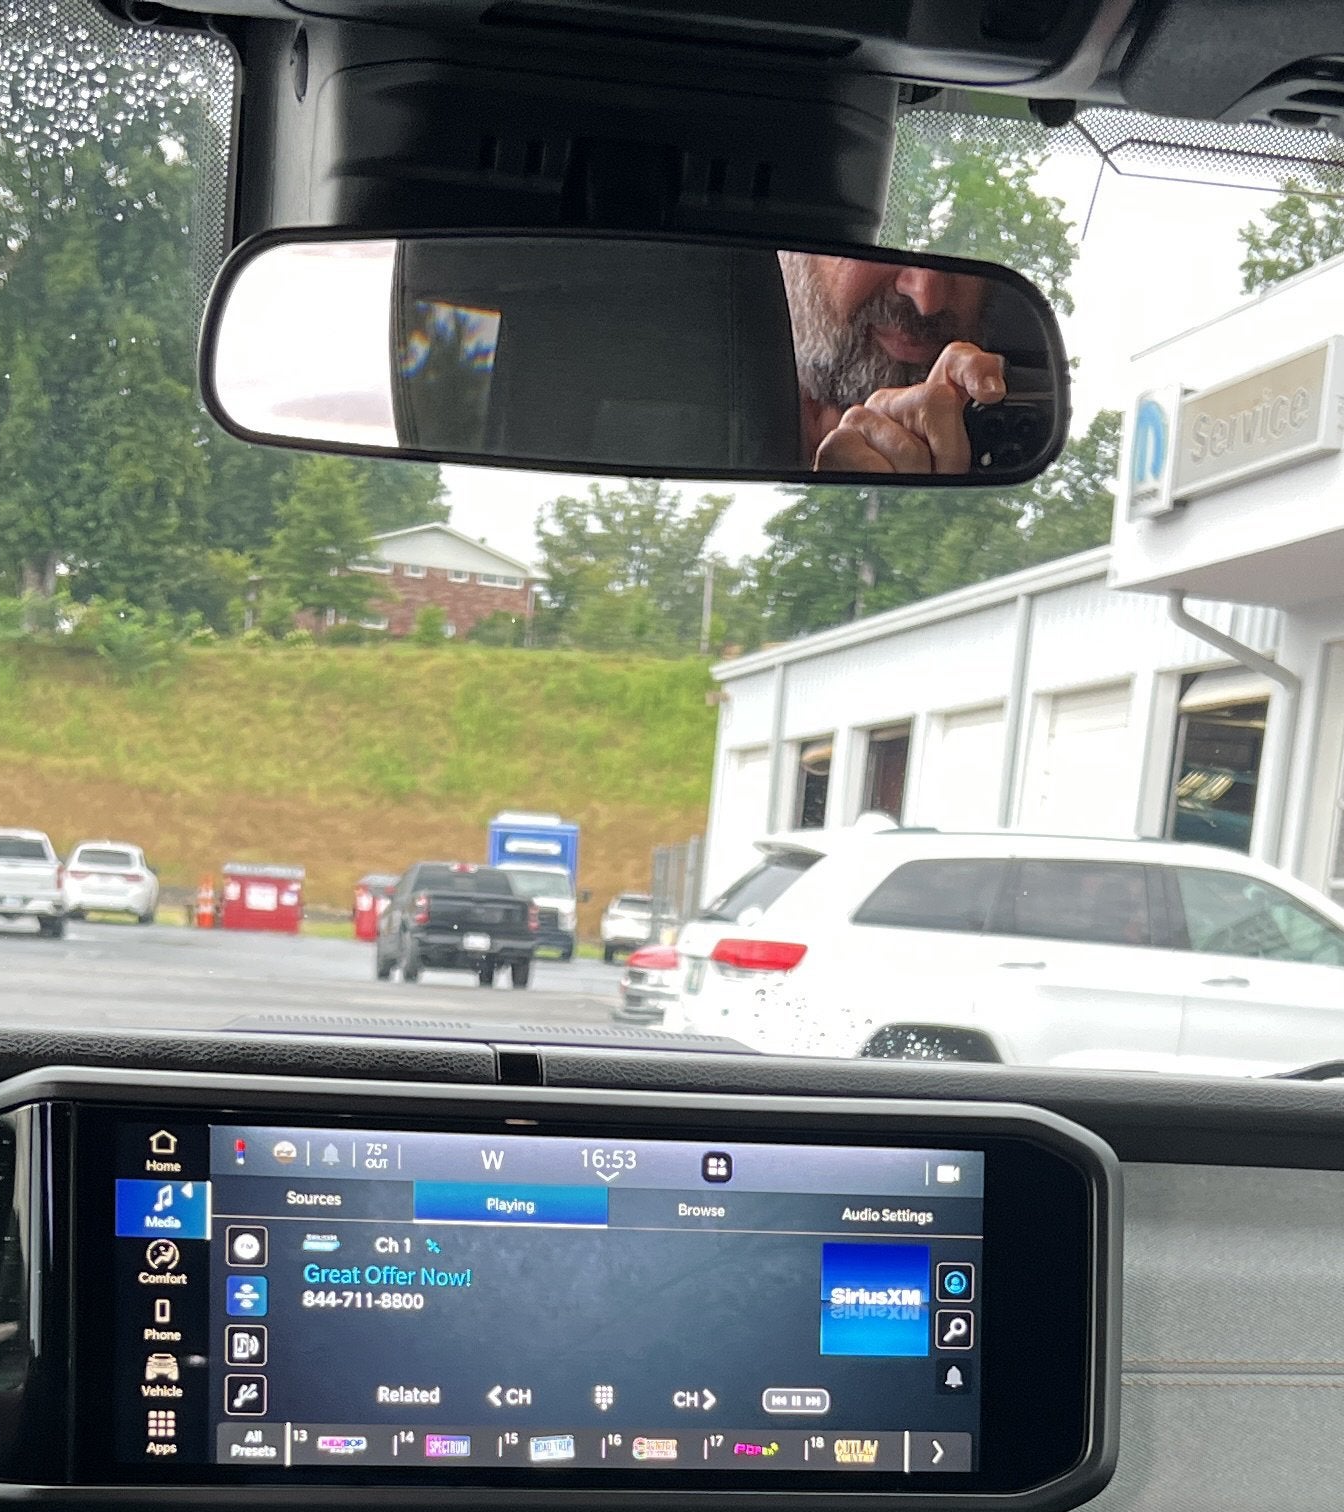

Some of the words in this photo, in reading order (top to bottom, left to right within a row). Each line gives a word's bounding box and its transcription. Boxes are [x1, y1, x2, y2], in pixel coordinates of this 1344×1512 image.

[1190, 386, 1311, 464] Service
[145, 1159, 182, 1173] Home
[364, 1157, 389, 1170] OUT
[480, 1149, 506, 1171] W
[580, 1149, 638, 1170] 16:53
[286, 1190, 343, 1206] Sources
[485, 1197, 537, 1215] Playing
[677, 1202, 727, 1218] Browse
[144, 1215, 182, 1230] Media
[842, 1207, 881, 1223] Audio
[881, 1207, 934, 1226] Settings
[373, 1236, 399, 1254] Ch
[402, 1237, 412, 1254] 1
[138, 1272, 188, 1285] Comfort
[303, 1263, 361, 1286] Great
[364, 1264, 416, 1287] Offer
[420, 1267, 472, 1288] Now!
[302, 1290, 425, 1310] 844-711-8800
[829, 1287, 922, 1307] SiriusXM
[143, 1328, 183, 1342] Phone
[141, 1384, 184, 1398] Vehicle
[376, 1385, 441, 1404] Related
[505, 1388, 533, 1406] CH
[673, 1391, 699, 1408] CH
[244, 1430, 264, 1443] All
[292, 1429, 308, 1442] 13
[399, 1430, 415, 1443] 14
[504, 1432, 519, 1445] 15
[607, 1433, 623, 1447] 16
[709, 1435, 724, 1447] 17
[810, 1436, 825, 1449] 18
[145, 1441, 178, 1456] Apps
[230, 1444, 278, 1459] Presets
